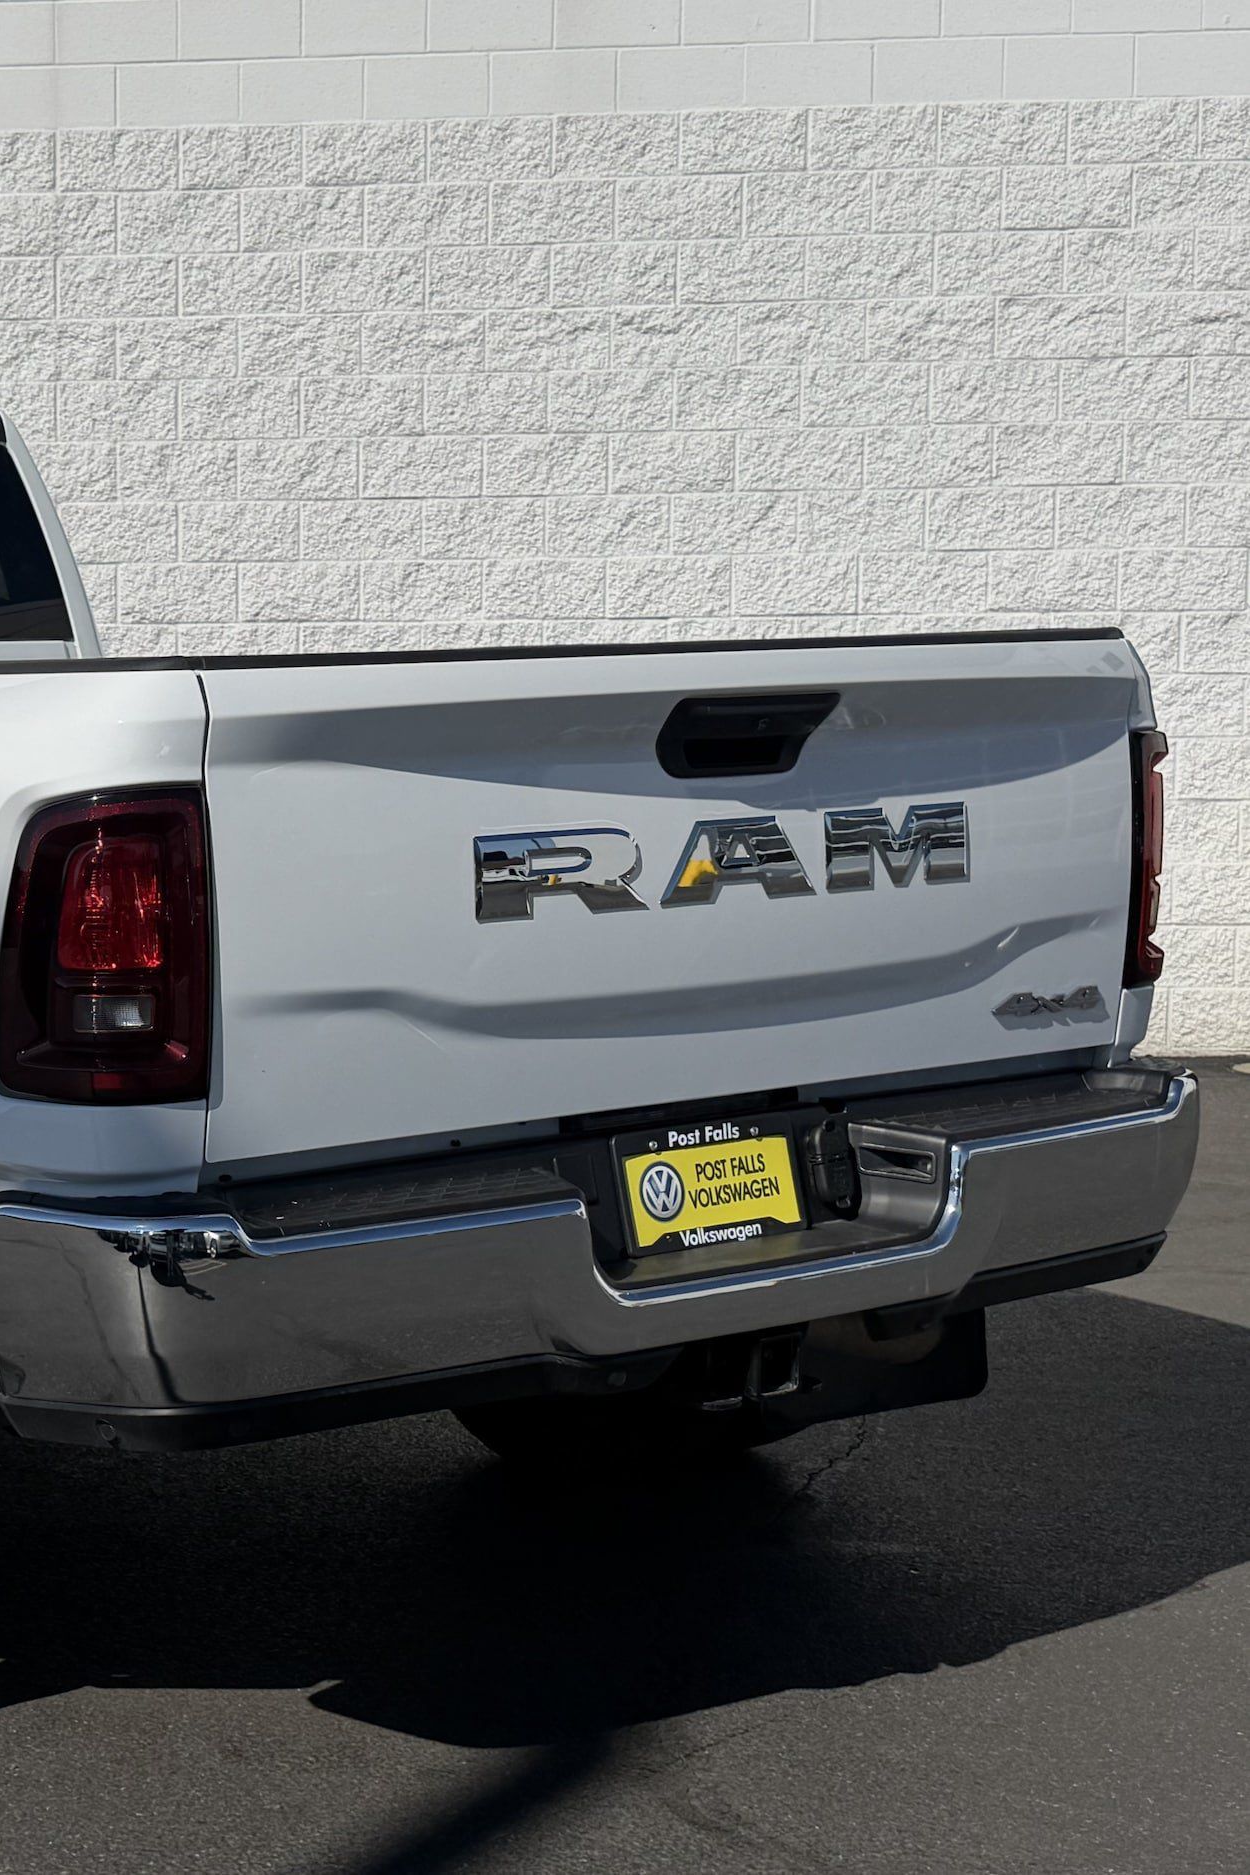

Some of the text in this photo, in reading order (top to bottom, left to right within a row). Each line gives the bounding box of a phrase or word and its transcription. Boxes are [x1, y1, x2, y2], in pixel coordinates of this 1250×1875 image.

[474, 801, 967, 923] RAM
[668, 1122, 740, 1148] Post Falls
[695, 1153, 766, 1183] POST FALLS
[688, 1176, 781, 1209] VOLKSWAGEN
[679, 1223, 763, 1248] Volkswagen
